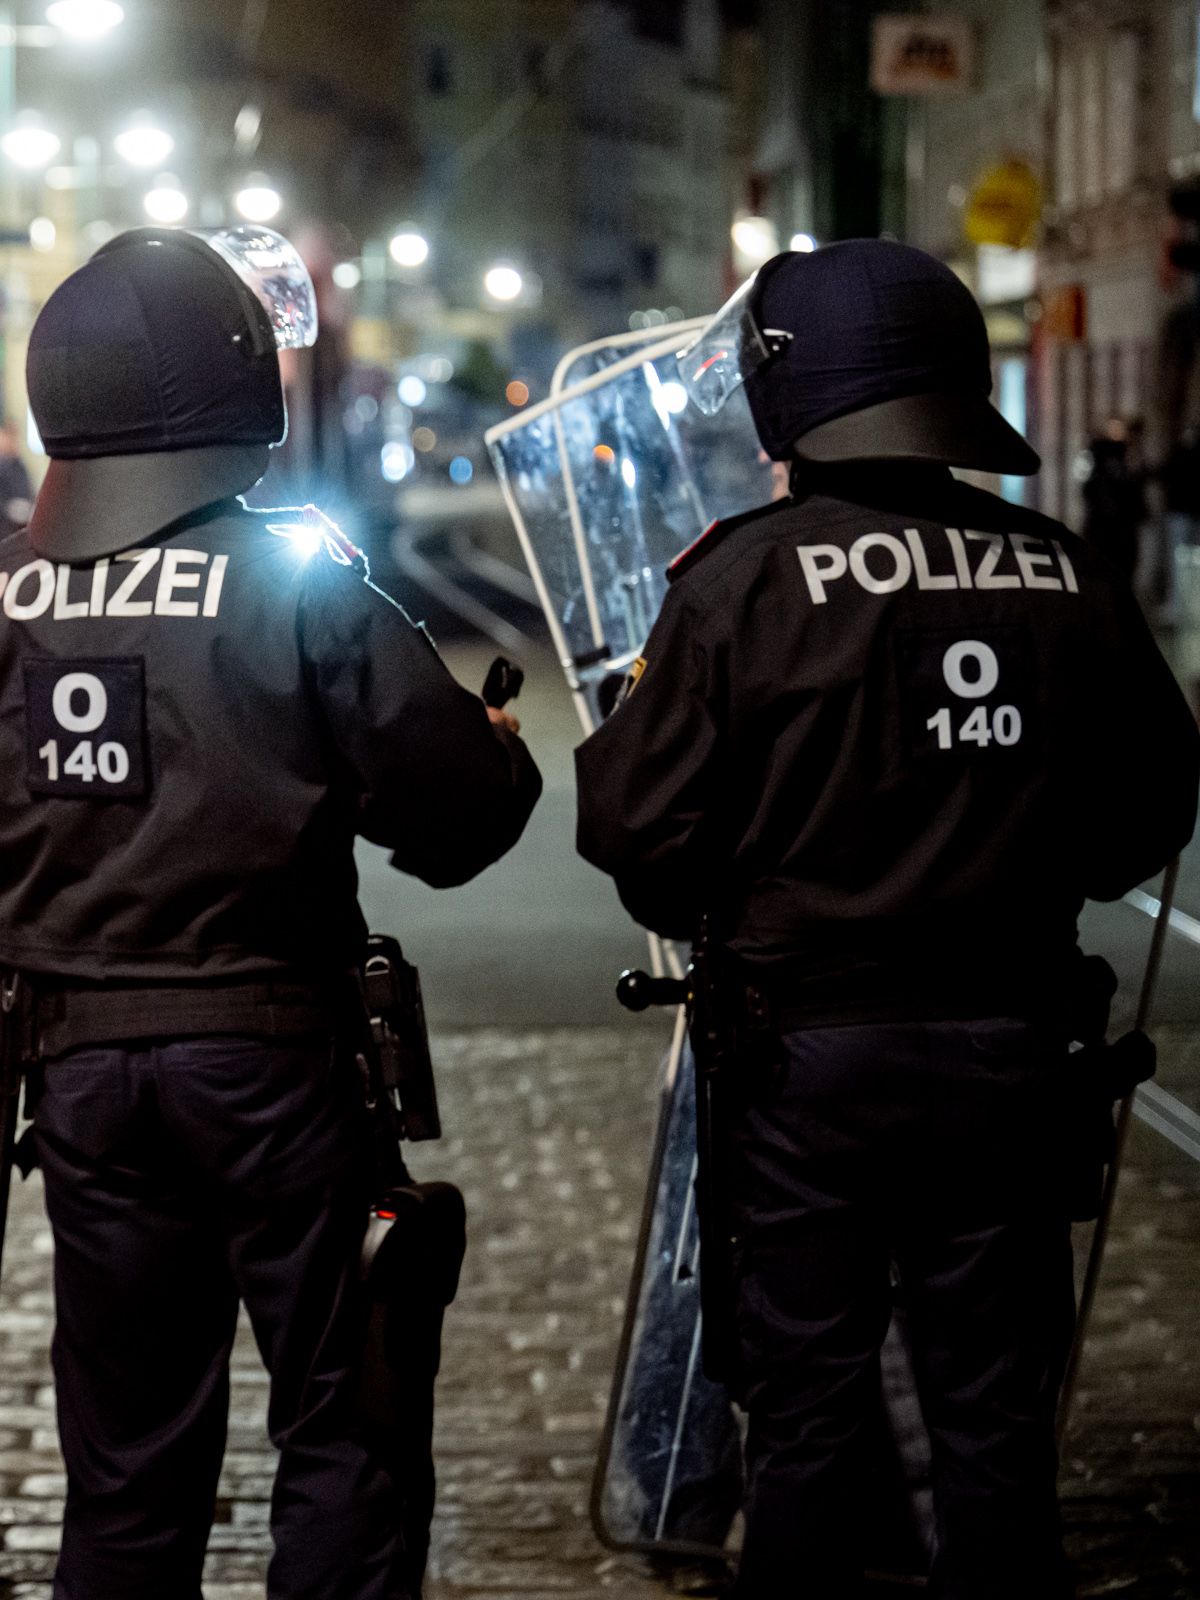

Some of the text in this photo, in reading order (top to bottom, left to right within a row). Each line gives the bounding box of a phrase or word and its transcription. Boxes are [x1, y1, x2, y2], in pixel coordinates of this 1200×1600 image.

[797, 527, 1080, 605] POLIZEI
[926, 704, 1023, 750] 140
[38, 739, 130, 784] 140
